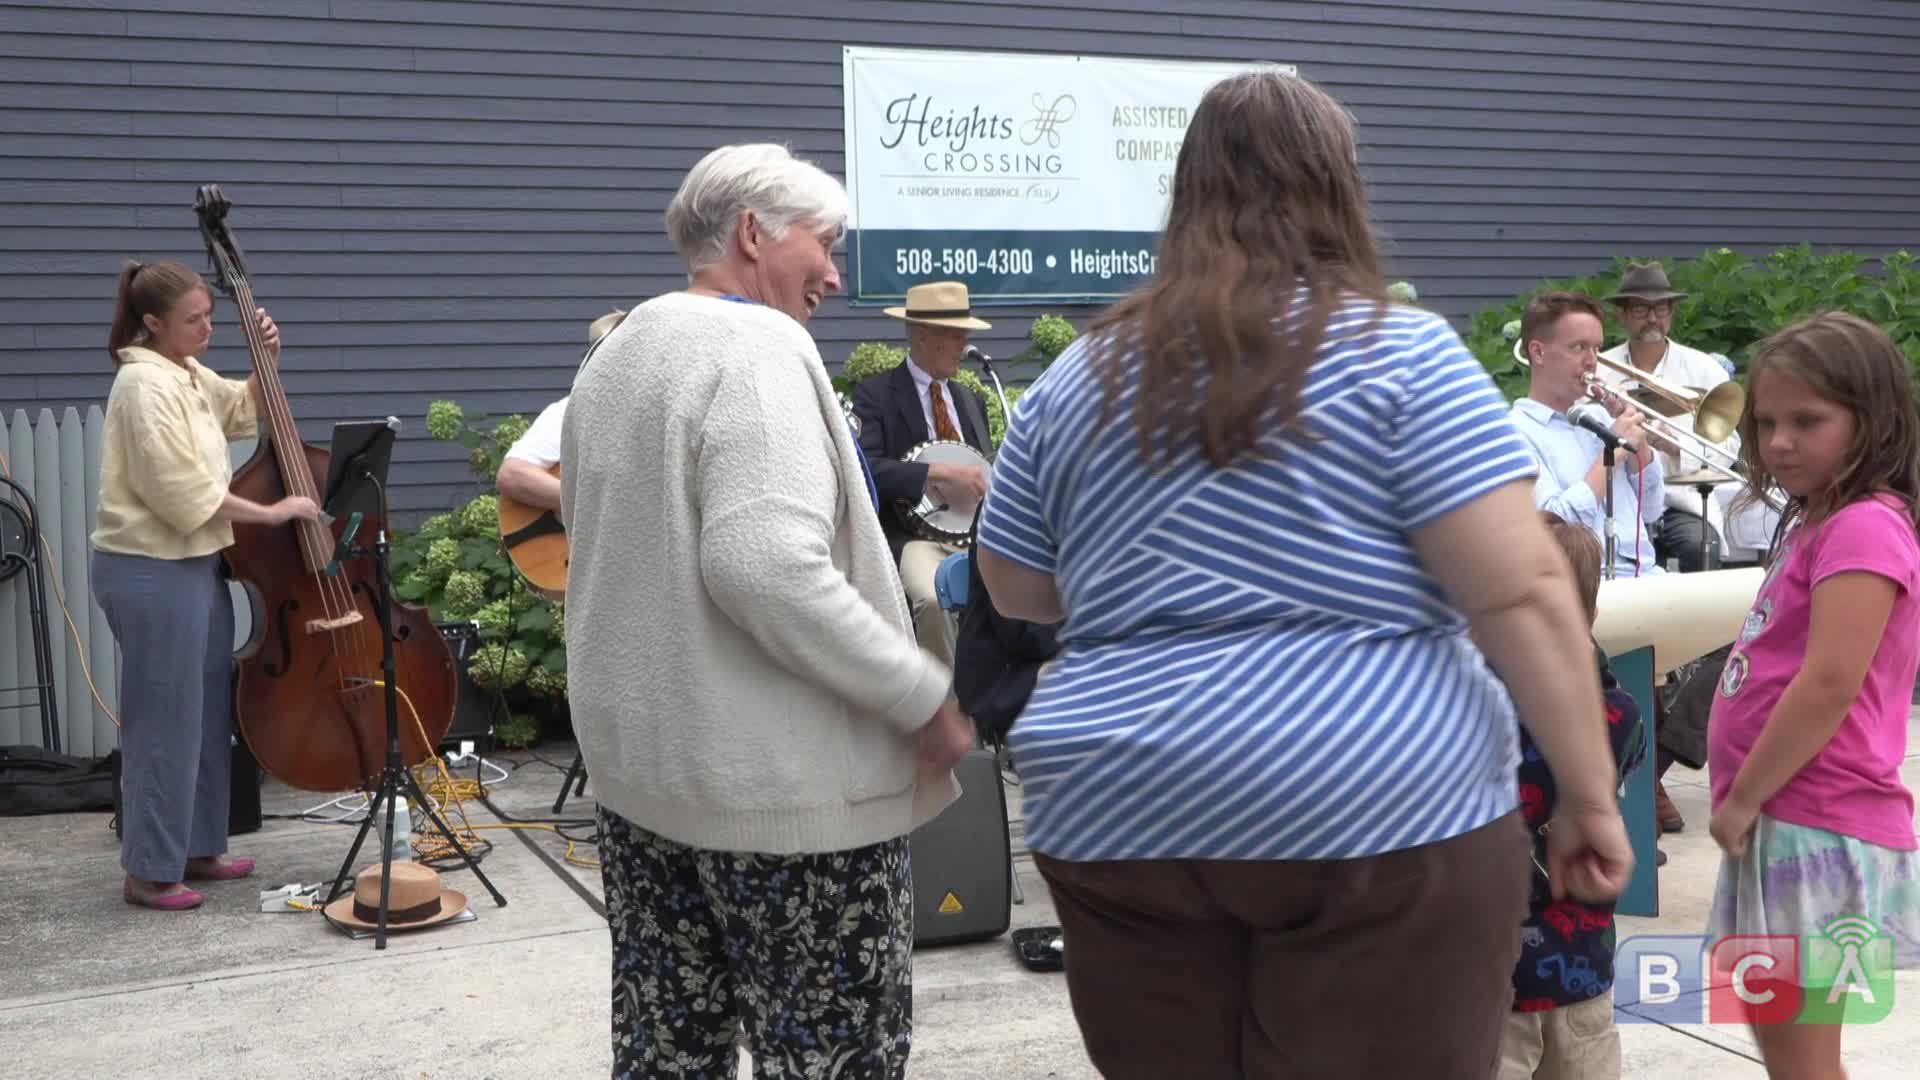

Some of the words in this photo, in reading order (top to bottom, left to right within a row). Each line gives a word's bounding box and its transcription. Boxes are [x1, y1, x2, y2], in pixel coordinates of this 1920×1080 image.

[879, 92, 1014, 153] Heights
[1111, 105, 1188, 129] ASSISTED
[923, 152, 1063, 174] CROSSING
[907, 186, 940, 198] SENIOR
[942, 186, 972, 198] LIVING
[974, 186, 1019, 198] RESIDENCE
[896, 248, 1034, 275] 508-580-4300
